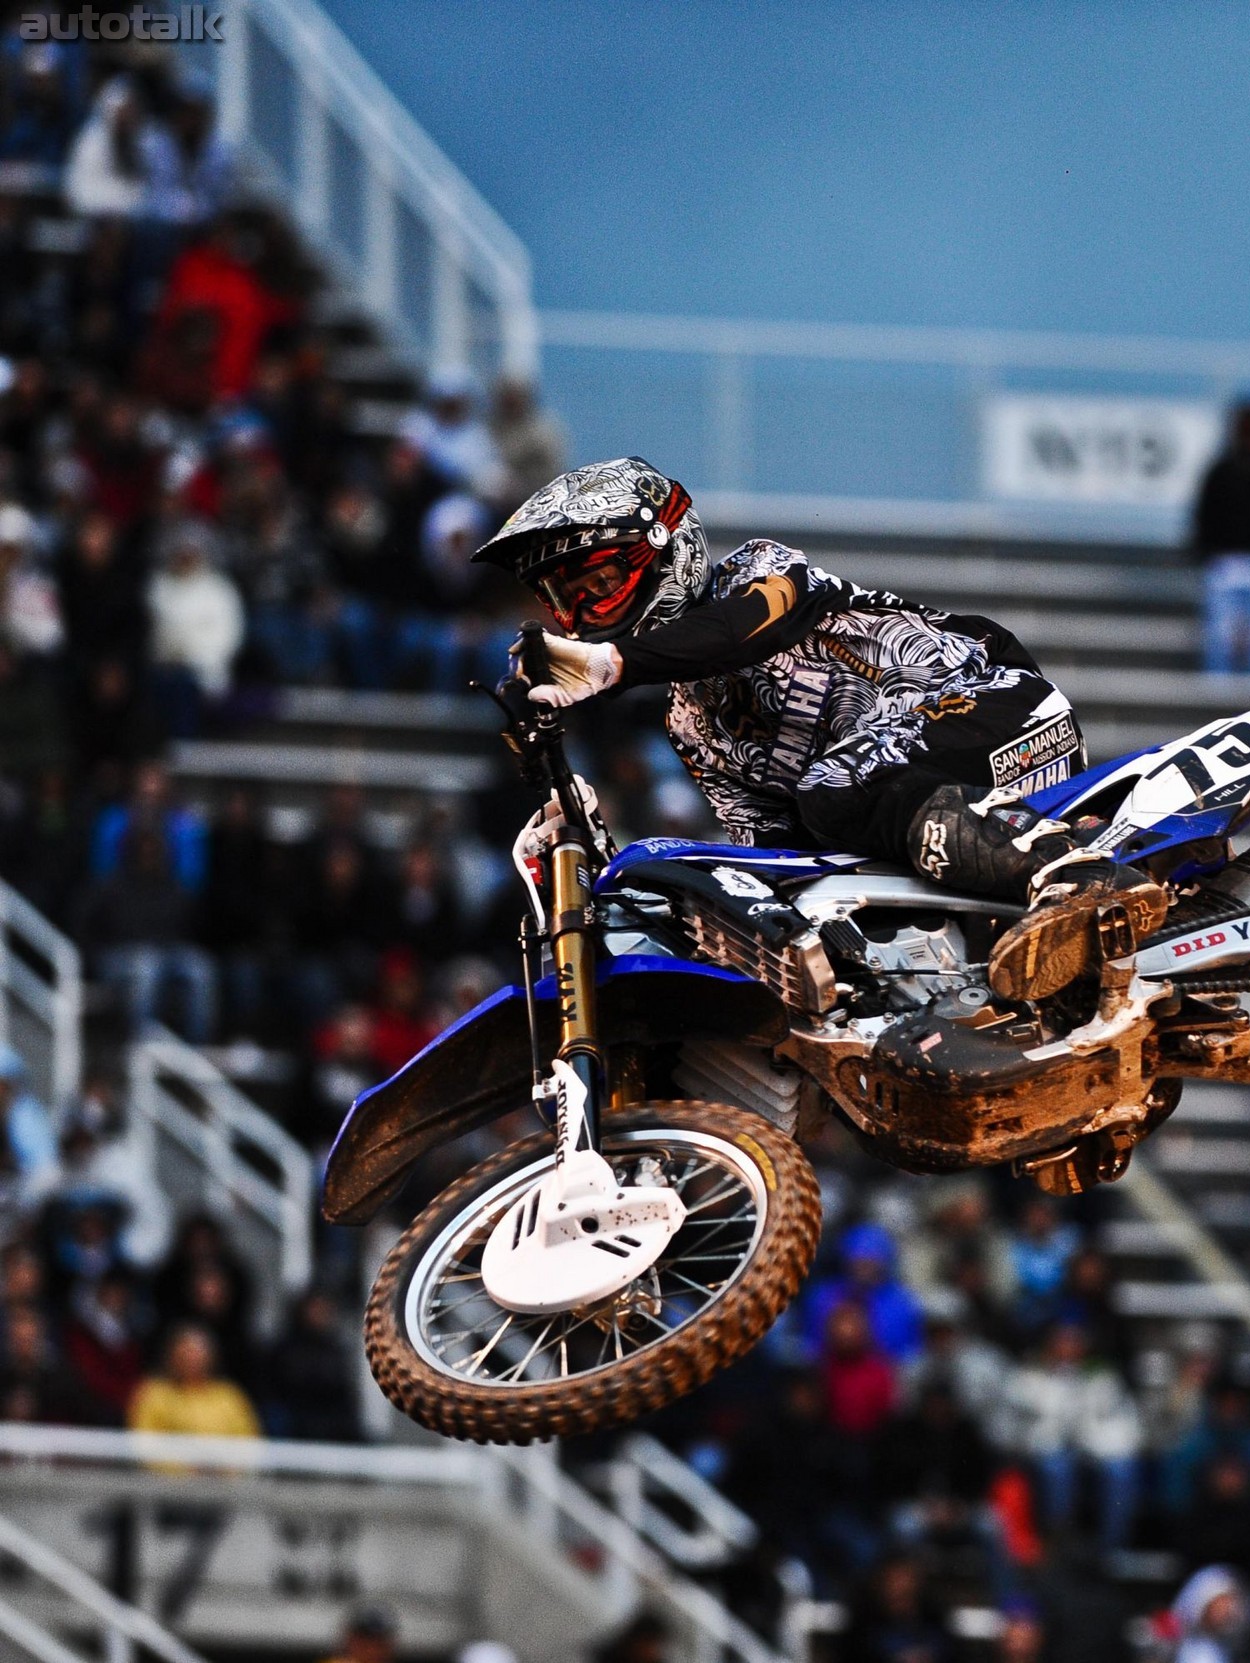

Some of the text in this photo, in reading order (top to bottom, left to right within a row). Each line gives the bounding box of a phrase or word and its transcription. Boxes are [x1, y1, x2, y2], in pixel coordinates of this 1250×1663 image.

[766, 670, 830, 780] YAMAHA
[995, 720, 1073, 775] SAN MANUEL
[998, 771, 1013, 786] BAND
[1032, 748, 1056, 765] MISSION
[1011, 760, 1068, 797] MAHA
[1214, 781, 1247, 802] HILL
